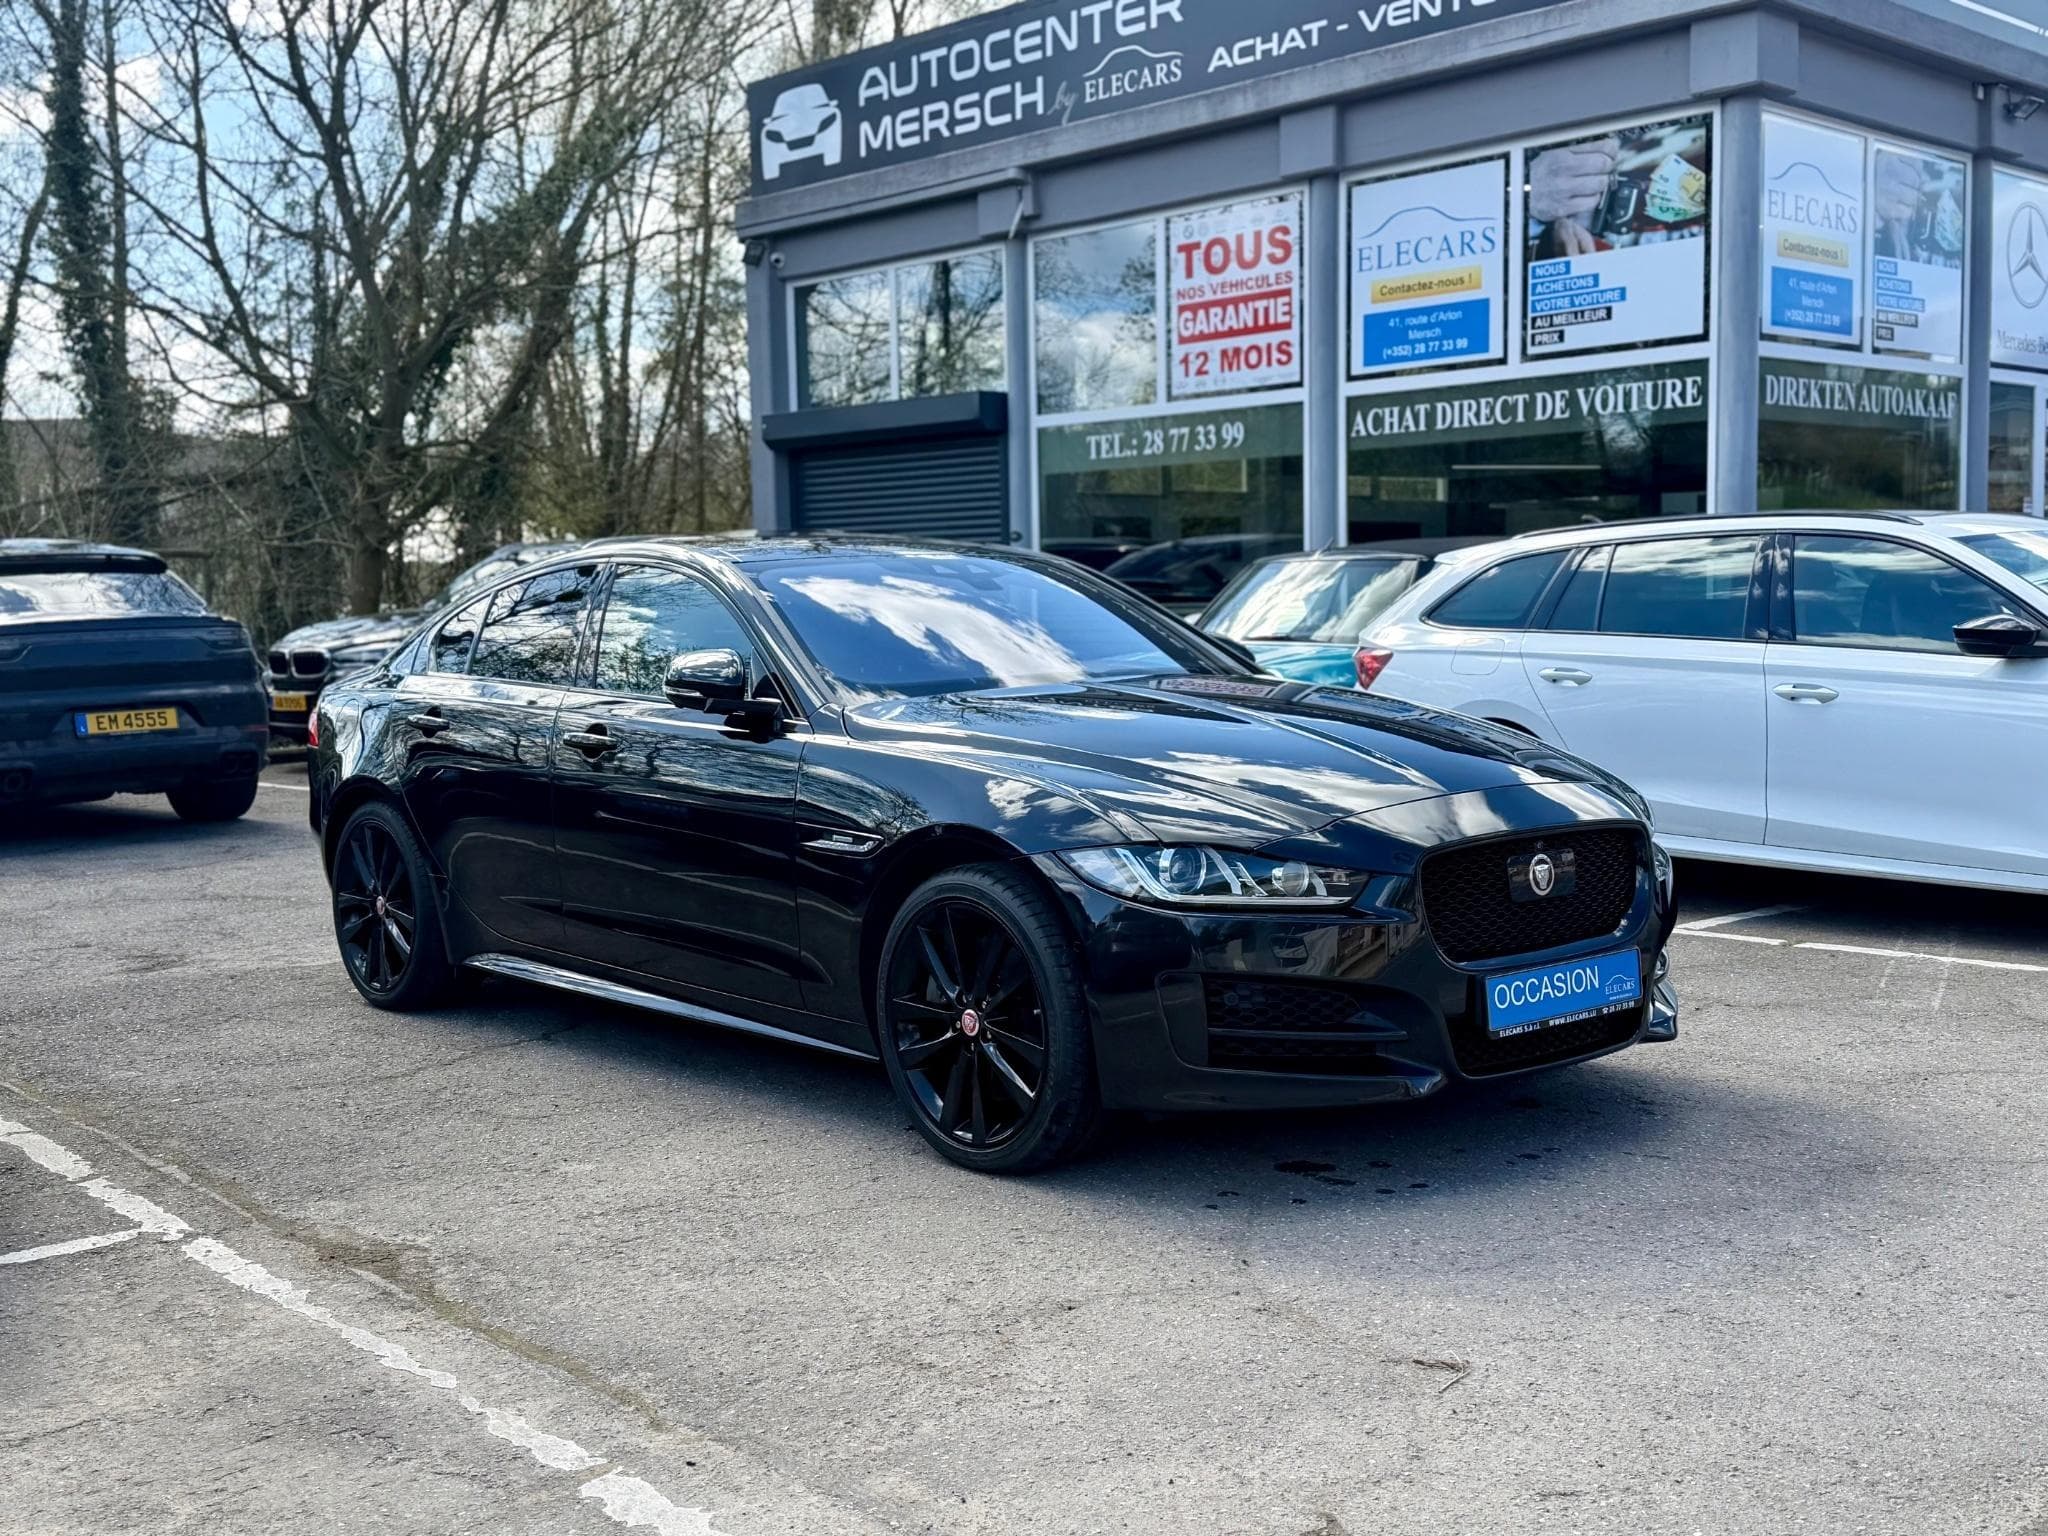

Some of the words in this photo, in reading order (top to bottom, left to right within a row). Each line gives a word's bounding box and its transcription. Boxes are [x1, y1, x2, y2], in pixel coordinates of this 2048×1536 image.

[858, 0, 1184, 107] AUTOCENTER
[1207, 19, 1328, 73] ACHAT
[1085, 58, 1182, 104] ELECARS
[859, 75, 1044, 158] MERSCH
[1768, 189, 1858, 234] ELECARS
[1177, 225, 1293, 280] TOUS
[1356, 226, 1497, 273] ELECARS
[1176, 285, 1205, 302] NOS
[1209, 270, 1294, 297] VEHICULES
[1379, 275, 1465, 297] Contactez-nous
[1535, 263, 1567, 278] NOUS
[1535, 276, 1595, 294] ACHETONS
[1178, 296, 1291, 338] GARANTIE
[1534, 297, 1572, 312] VOTRE
[1573, 289, 1621, 306] VOITURE
[1534, 315, 1551, 328] AU
[1552, 307, 1608, 325] MEILLEUR
[1383, 344, 1412, 359] (+352)
[1414, 342, 1426, 354] 28
[1428, 341, 1440, 352] 77
[1441, 339, 1454, 351] 33
[1456, 338, 1468, 349] 99
[1408, 328, 1442, 340] Mersch
[1534, 332, 1560, 345] PRIX
[1179, 351, 1210, 378] 12
[1220, 340, 1293, 373] MOIS
[1351, 403, 1430, 438] ACHAT
[1435, 393, 1530, 431] DIRECT
[1535, 388, 1571, 422] DE
[1576, 375, 1704, 417] VOITURE
[1765, 374, 1856, 412] DIREKTEN
[1086, 432, 1138, 460] TEL.:
[1142, 429, 1164, 455] 28
[1168, 427, 1191, 453] 77
[1194, 424, 1217, 451] 33
[1221, 421, 1245, 449] 99
[95, 713, 120, 731] EM
[123, 711, 168, 729] 4555
[1494, 965, 1600, 1009] OCCASION
[1605, 980, 1636, 995] ELECARS
[1499, 1025, 1524, 1038] ELECARS
